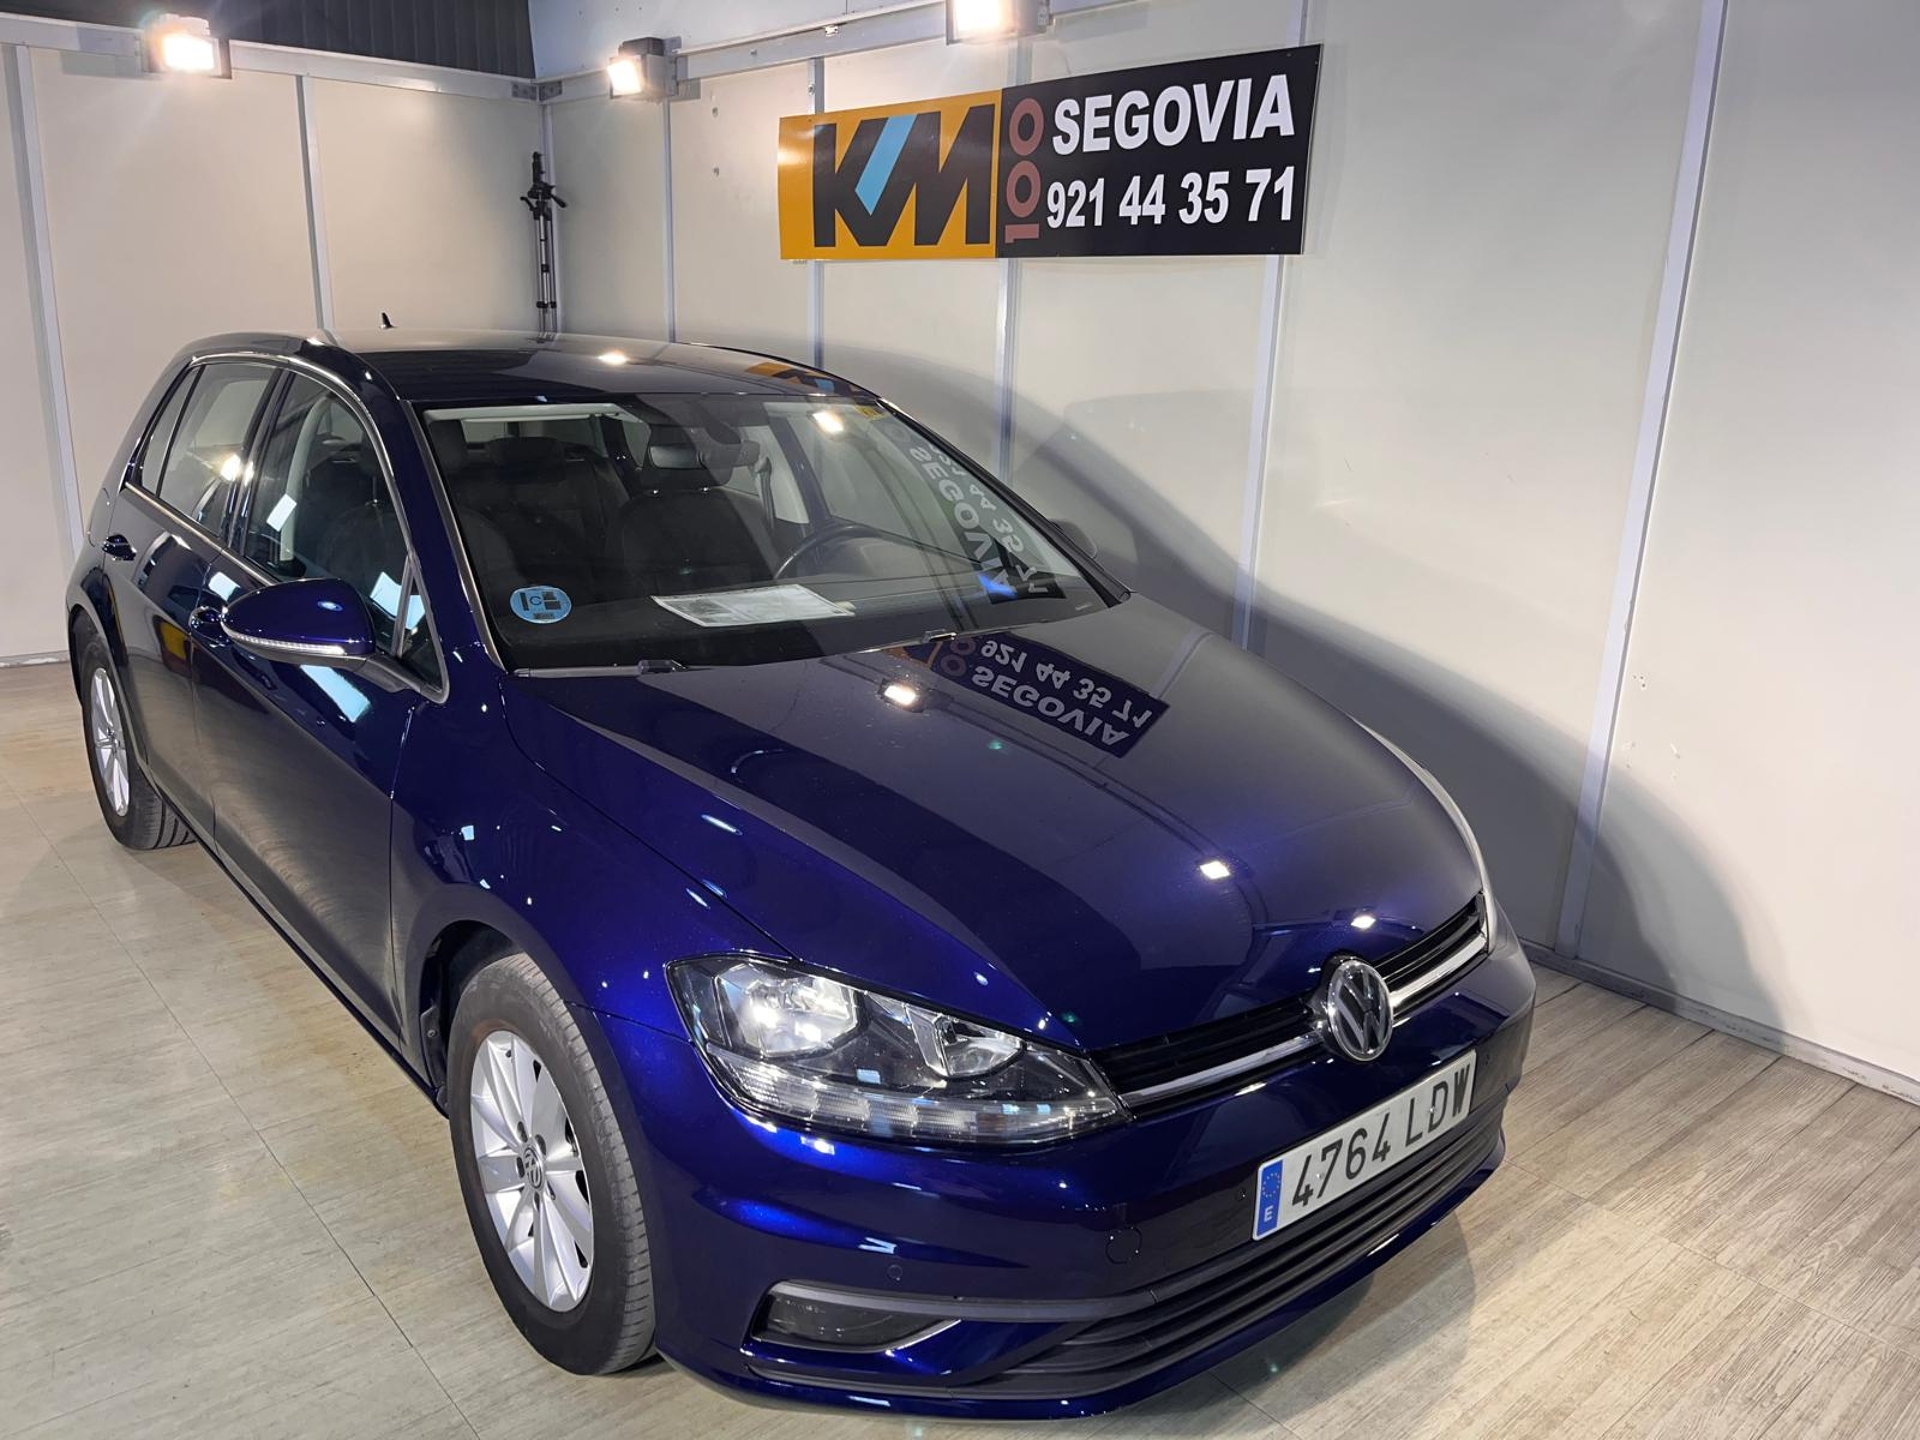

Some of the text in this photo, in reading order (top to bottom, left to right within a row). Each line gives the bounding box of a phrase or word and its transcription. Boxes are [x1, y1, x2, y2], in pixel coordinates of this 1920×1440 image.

[1005, 98, 1044, 243] 100
[1052, 74, 1295, 156] SEGOVIA
[813, 104, 995, 248] KM
[1047, 165, 1296, 229] 921 44 35 71
[1291, 1063, 1471, 1207] 4764 LDW
[1263, 1205, 1273, 1222] E
